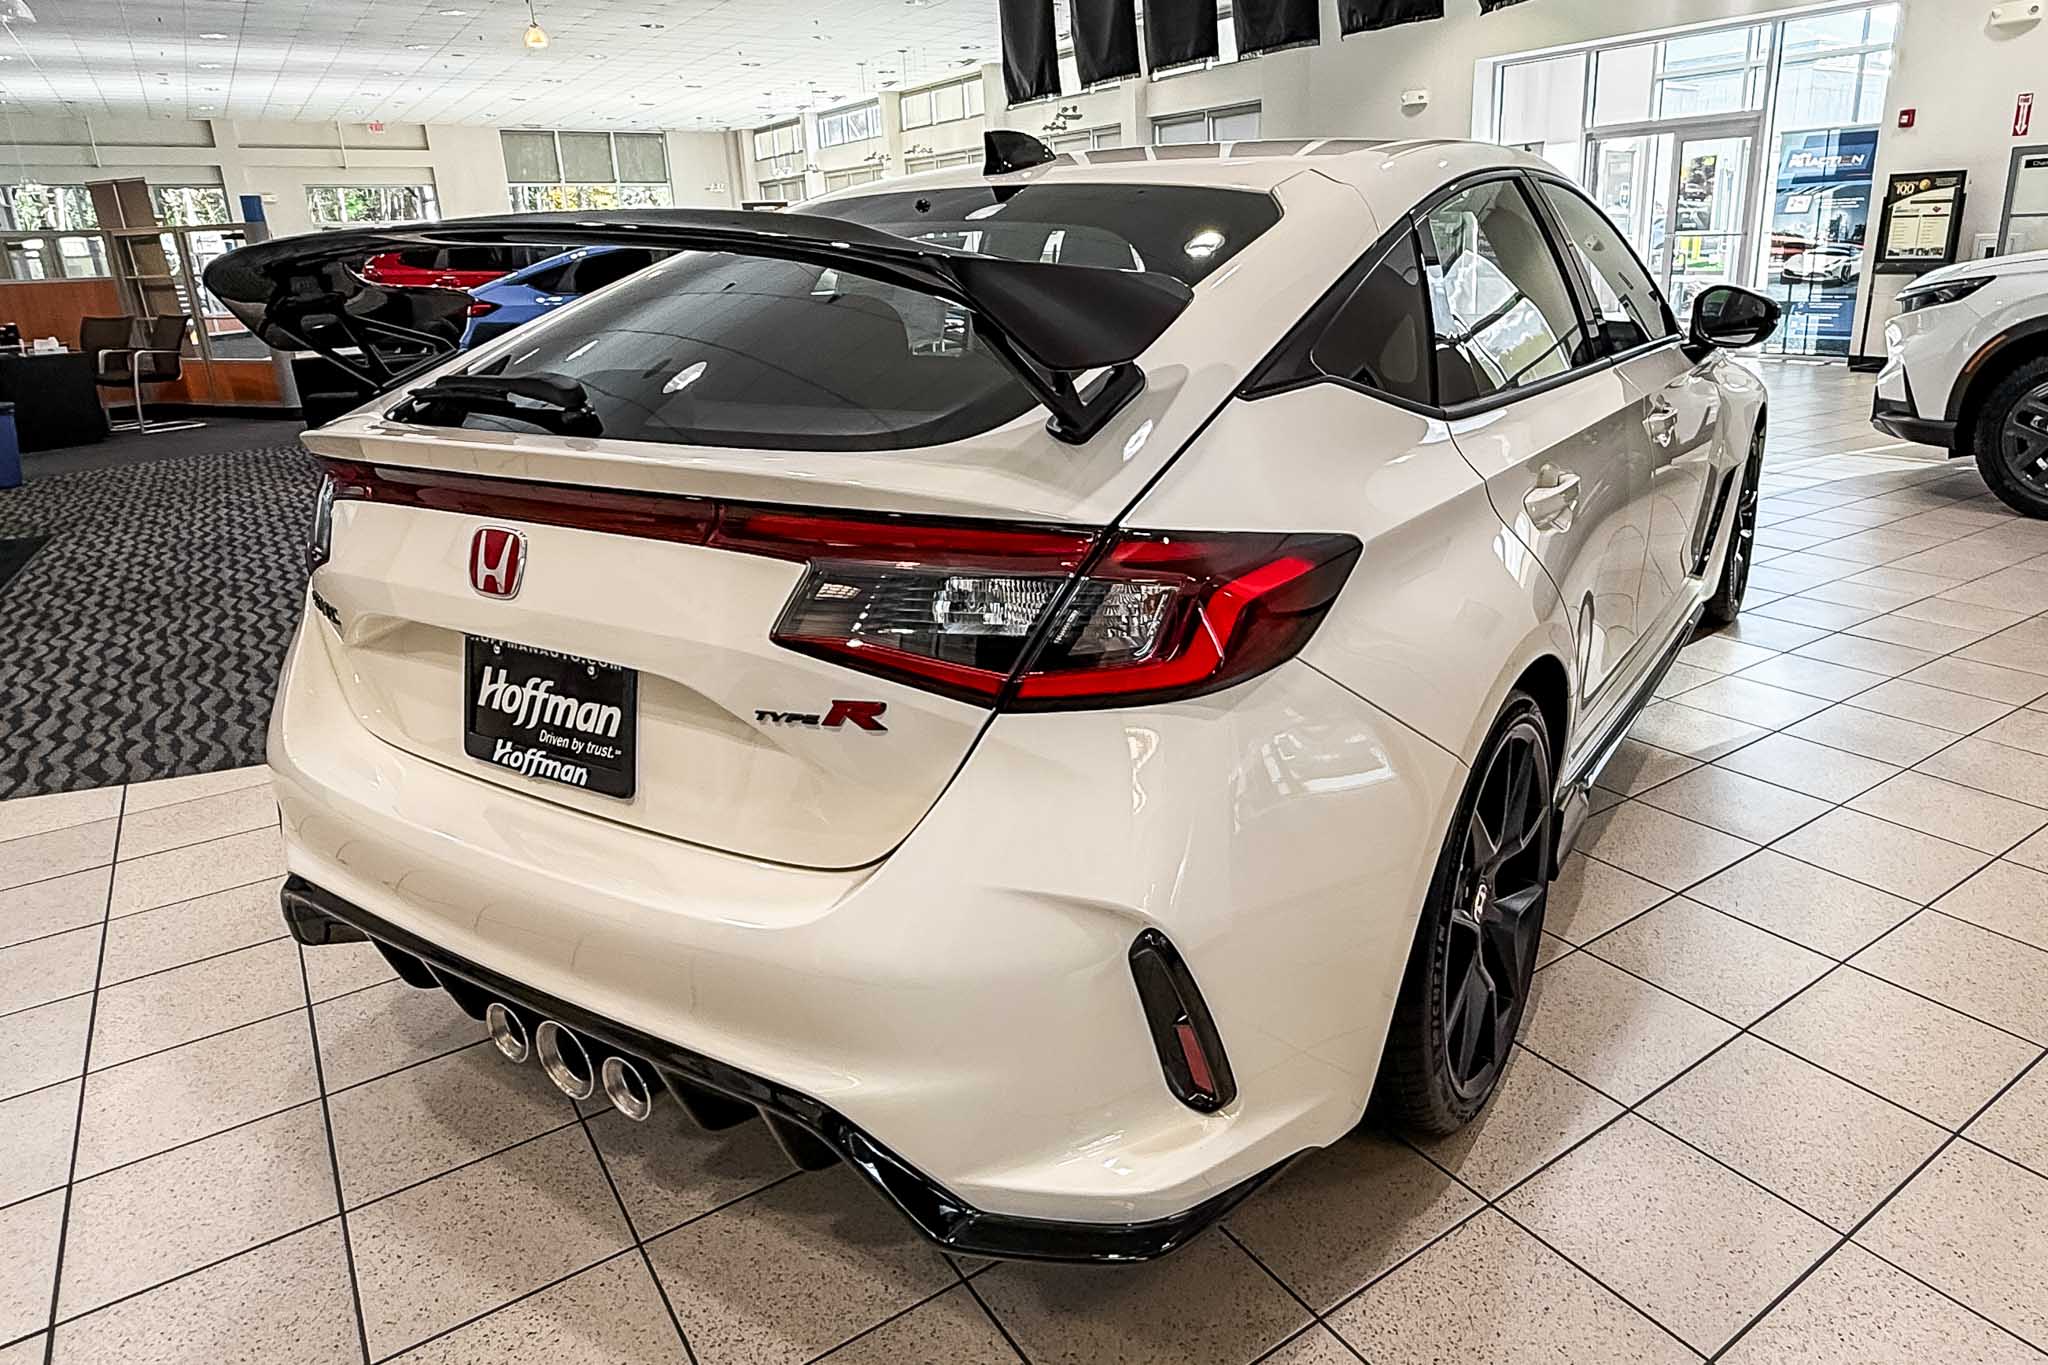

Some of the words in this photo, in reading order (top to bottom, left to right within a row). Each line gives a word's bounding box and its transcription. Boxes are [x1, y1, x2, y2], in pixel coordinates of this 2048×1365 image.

[477, 665, 622, 738] Hoffman
[755, 710, 820, 725] TYPE
[821, 700, 888, 731] R
[538, 729, 571, 748] Driven
[571, 738, 585, 754] by
[493, 739, 588, 786] Hoffman
